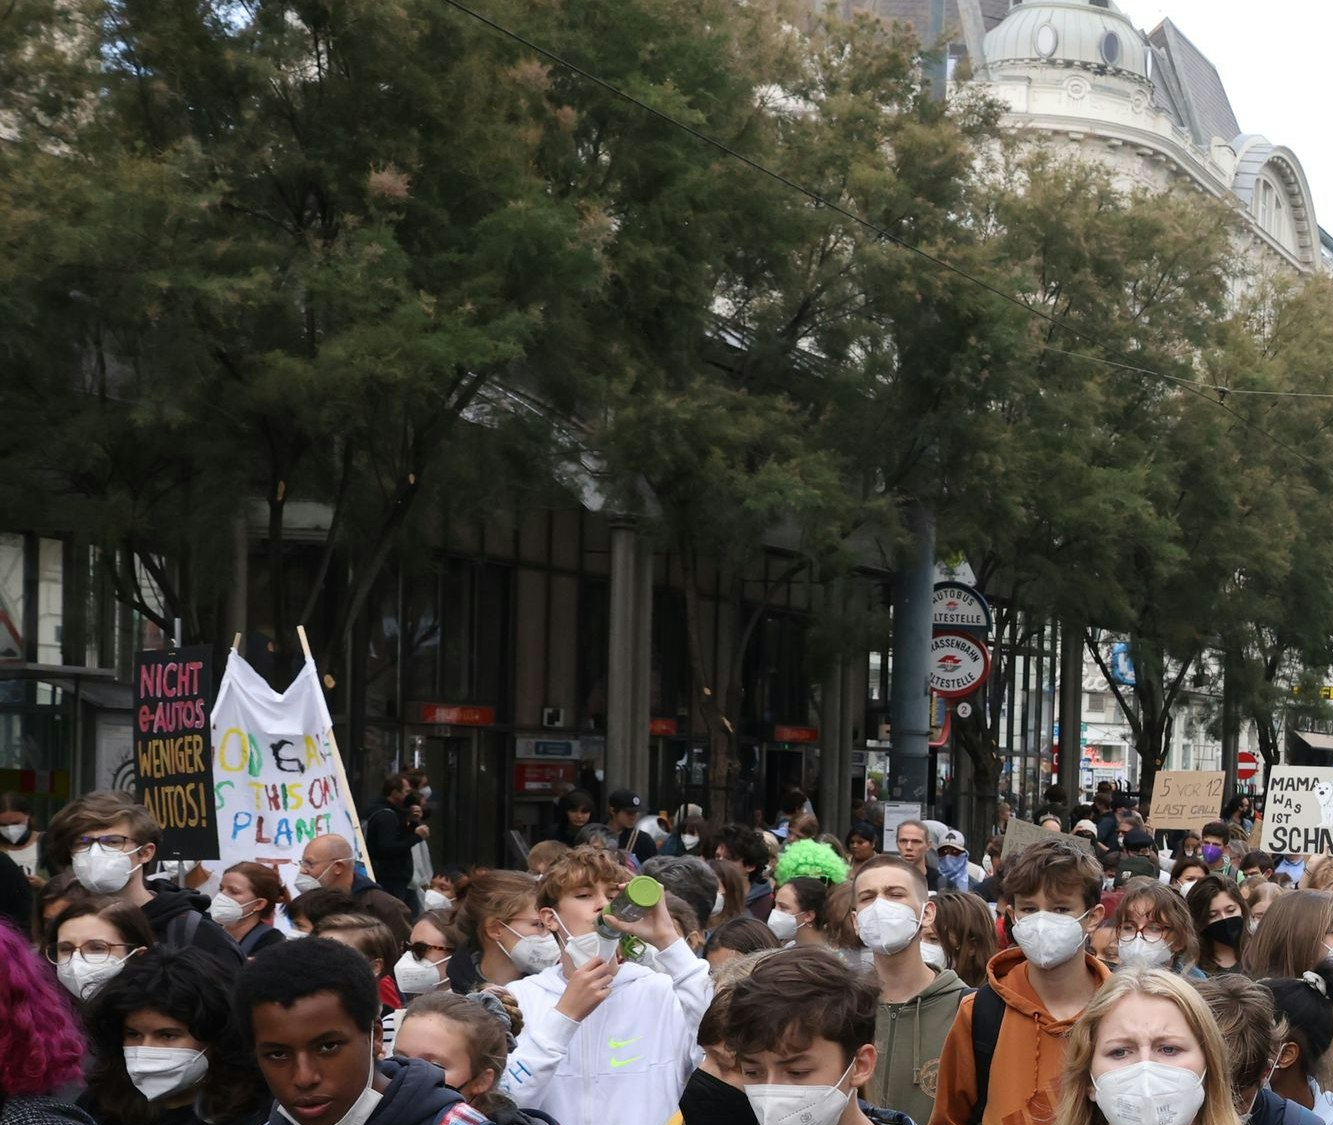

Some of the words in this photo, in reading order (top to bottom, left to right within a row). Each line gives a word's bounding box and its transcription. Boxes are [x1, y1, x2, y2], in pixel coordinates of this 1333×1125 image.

[933, 590, 975, 606] AUTOBUS
[934, 613, 981, 624] LTESTELLE
[140, 662, 203, 698] NICHT
[930, 672, 976, 688] LTESTELLE
[139, 698, 205, 733] e-AUTOS
[138, 735, 205, 779] WENIGER
[211, 727, 262, 777] OD
[1160, 778, 1173, 797] 5
[1178, 783, 1200, 796] VOR
[1206, 778, 1222, 797] 12
[1270, 777, 1320, 791] MAMA
[144, 783, 207, 829] AUTOS!
[247, 781, 304, 812] THIS
[1273, 794, 1302, 814] WAS
[1154, 804, 1187, 815] LAST
[1272, 813, 1291, 824] IST
[230, 811, 332, 846] PLANET
